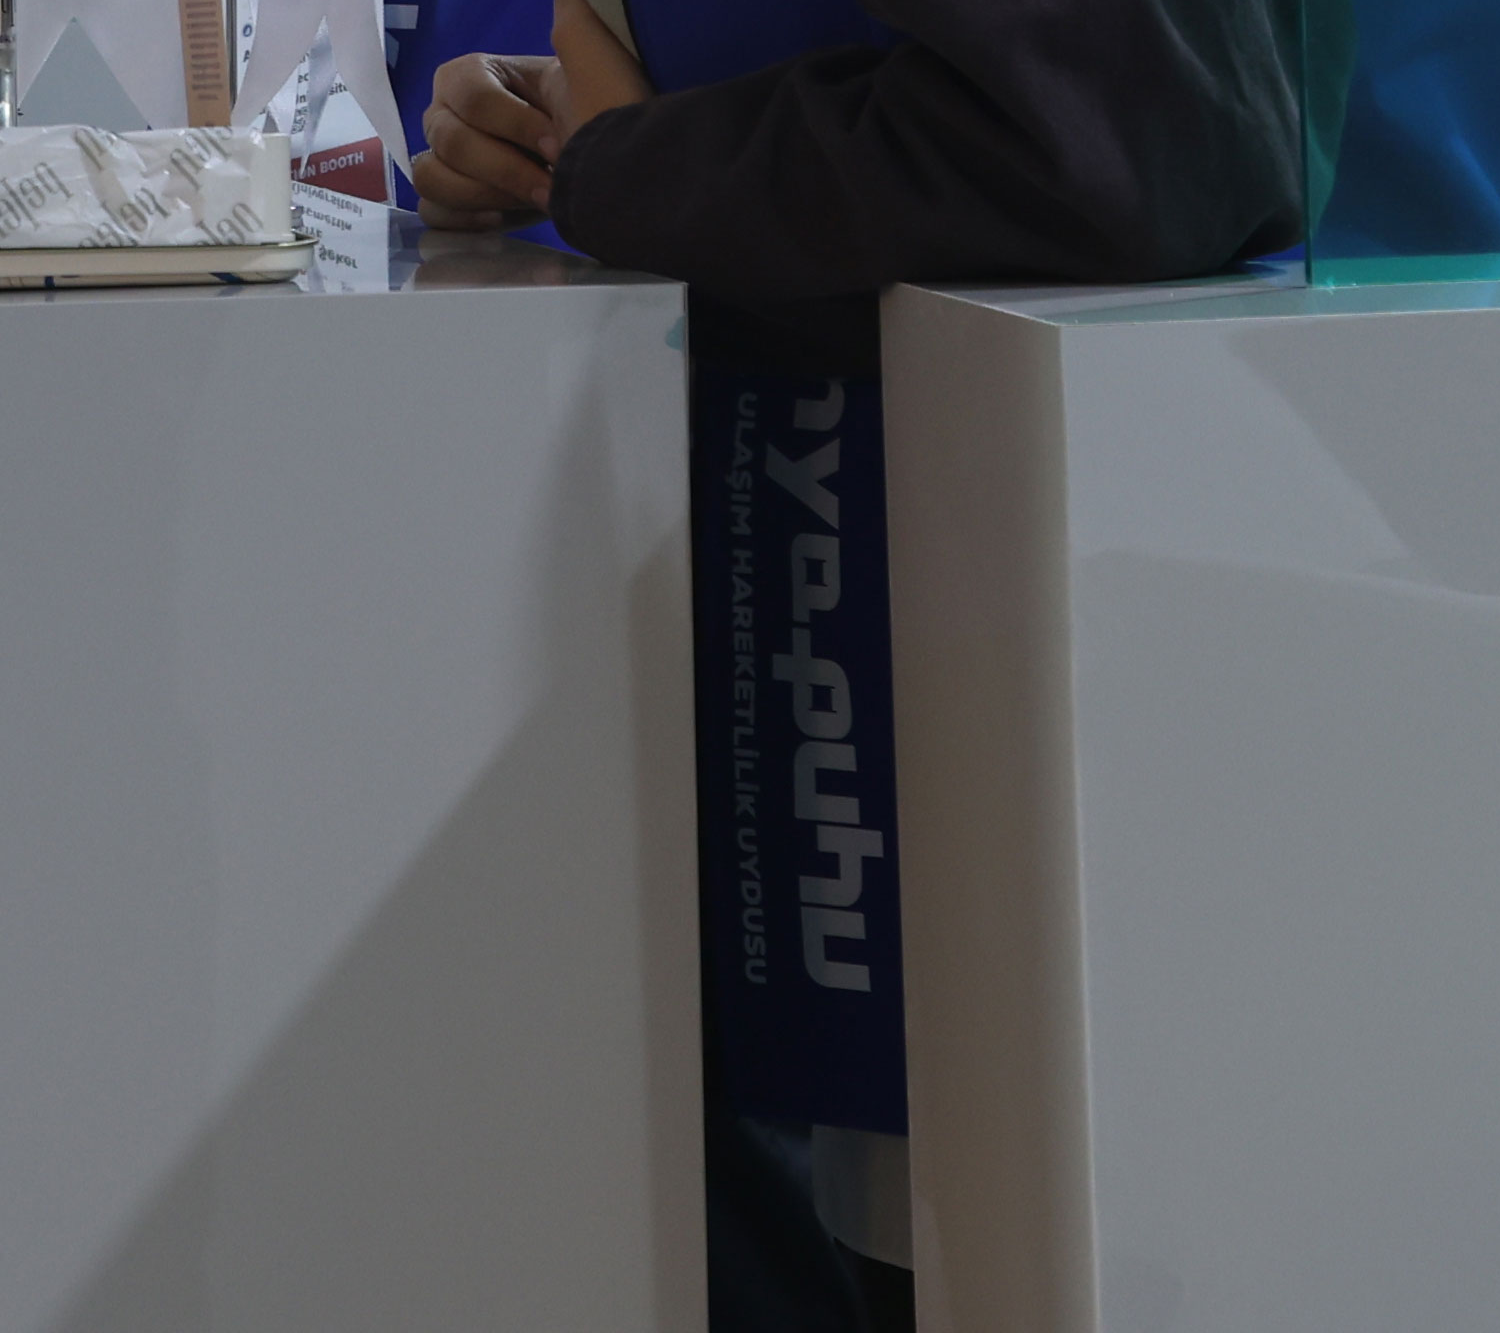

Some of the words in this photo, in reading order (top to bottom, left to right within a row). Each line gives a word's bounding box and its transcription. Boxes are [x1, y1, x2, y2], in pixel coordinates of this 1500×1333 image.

[320, 151, 365, 174] BOOTH
[724, 391, 759, 536] ULAŞIM
[730, 548, 758, 818] HAREKETLİLİK
[736, 827, 768, 986] UYDUSU
